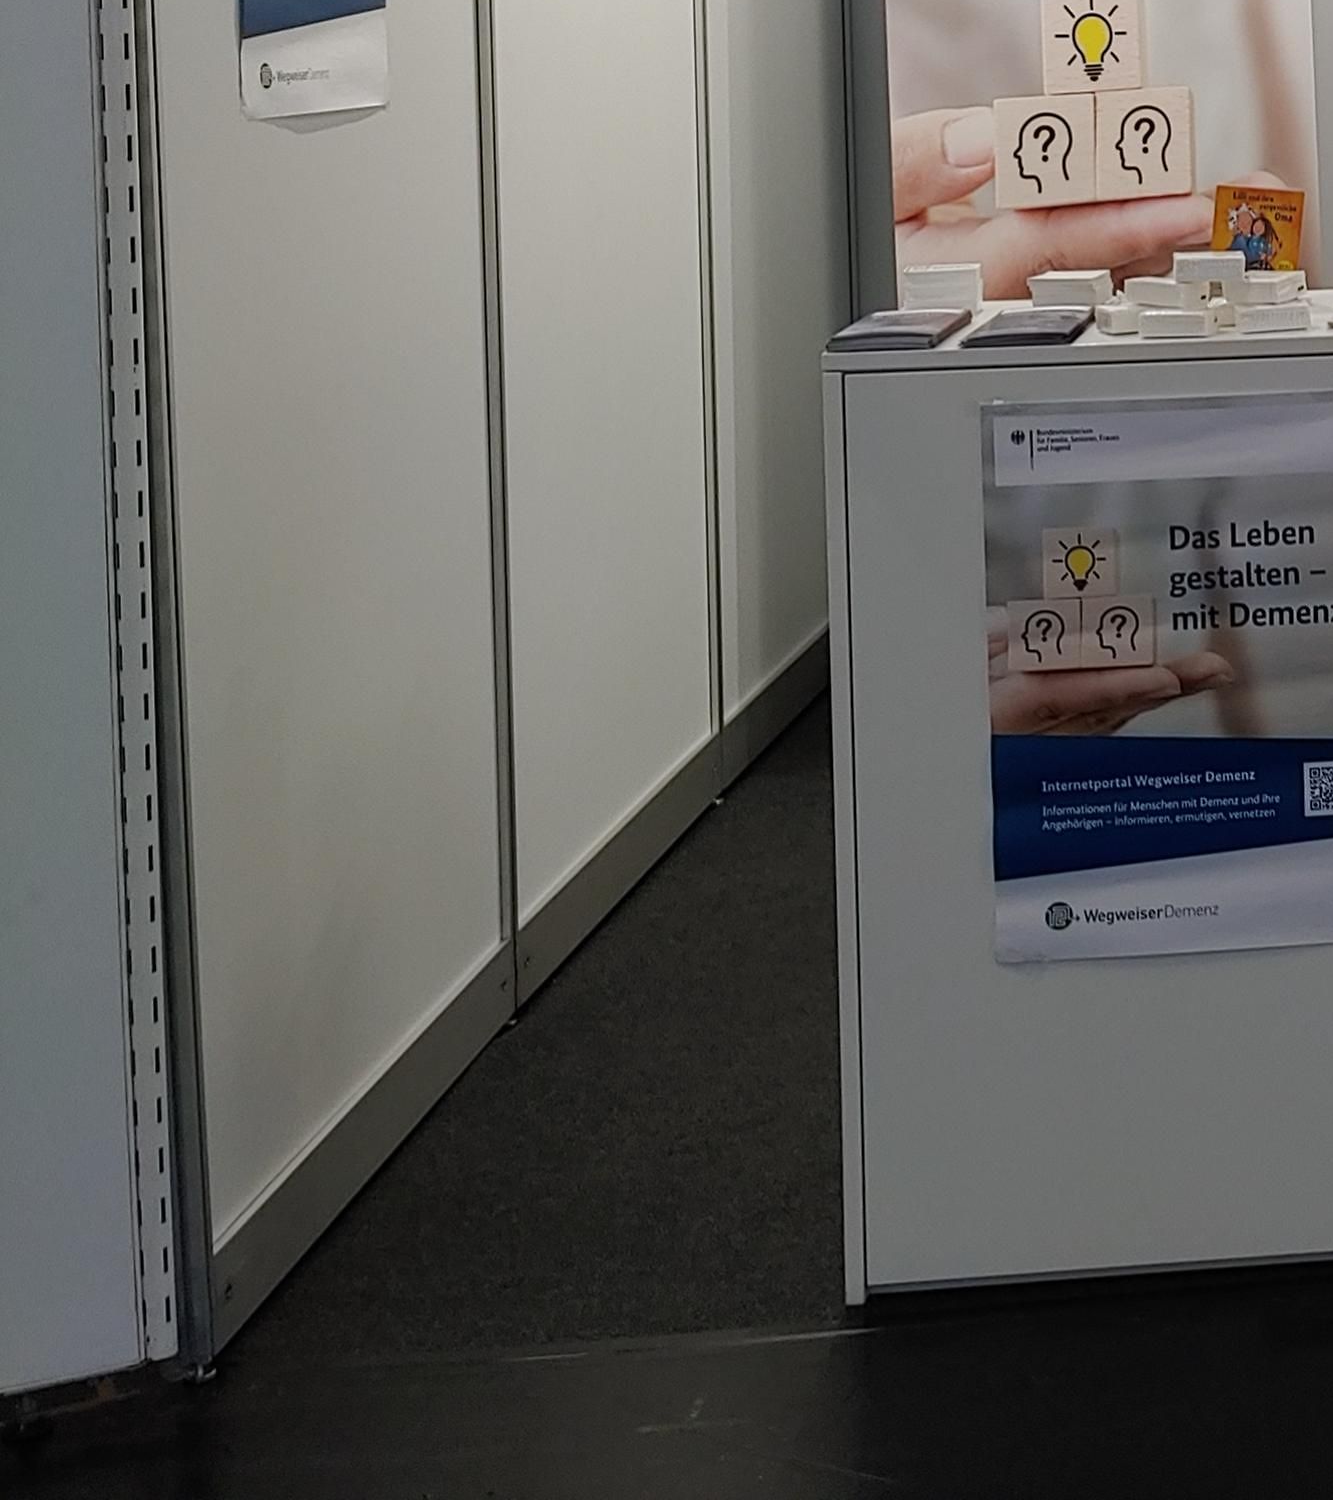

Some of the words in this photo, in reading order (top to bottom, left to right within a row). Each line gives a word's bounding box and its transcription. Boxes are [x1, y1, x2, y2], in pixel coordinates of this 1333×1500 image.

[1168, 525, 1220, 550] Das
[1230, 520, 1314, 547] Leben
[1170, 562, 1299, 597] gestalten
[1172, 604, 1220, 630] mit
[1042, 775, 1132, 792] Internetportal
[1134, 772, 1201, 788] Wegweiser
[1205, 770, 1256, 783] Demenz
[1042, 802, 1111, 816] Informationen
[1114, 801, 1127, 812] für
[1130, 799, 1179, 811] Menschen
[1181, 797, 1198, 808] mit
[1200, 797, 1239, 807] Demenz
[1241, 795, 1260, 805] und
[1229, 808, 1275, 819] vernetzen
[1084, 902, 1219, 924] WegweiserDemenz
